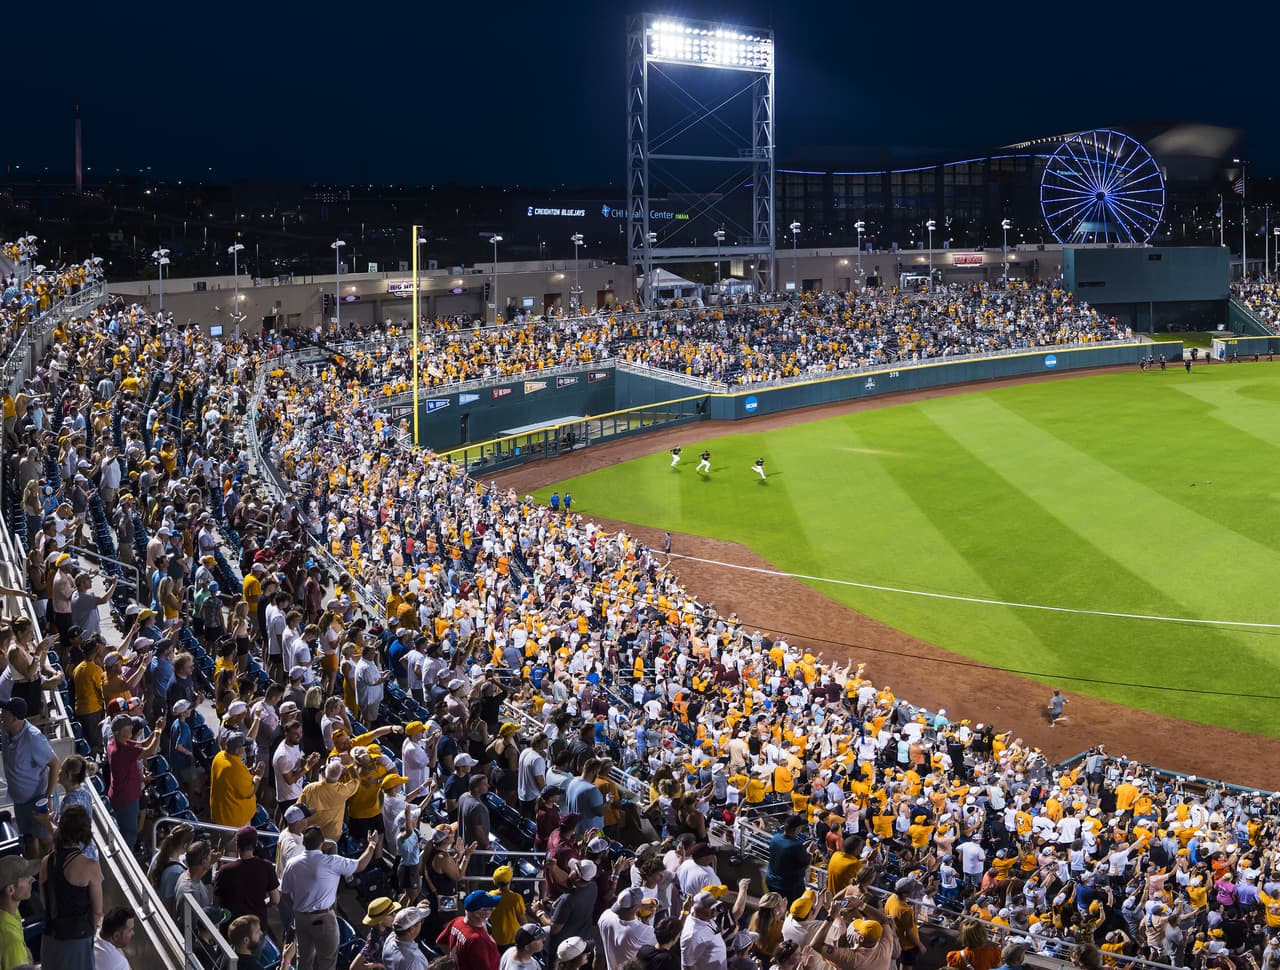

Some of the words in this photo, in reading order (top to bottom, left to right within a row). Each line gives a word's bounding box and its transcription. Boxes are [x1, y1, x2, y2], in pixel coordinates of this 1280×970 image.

[534, 208, 560, 216] CREIGHTON
[561, 208, 586, 217] BLUEJAYS
[611, 210, 623, 218] CHI
[650, 210, 674, 219] Center
